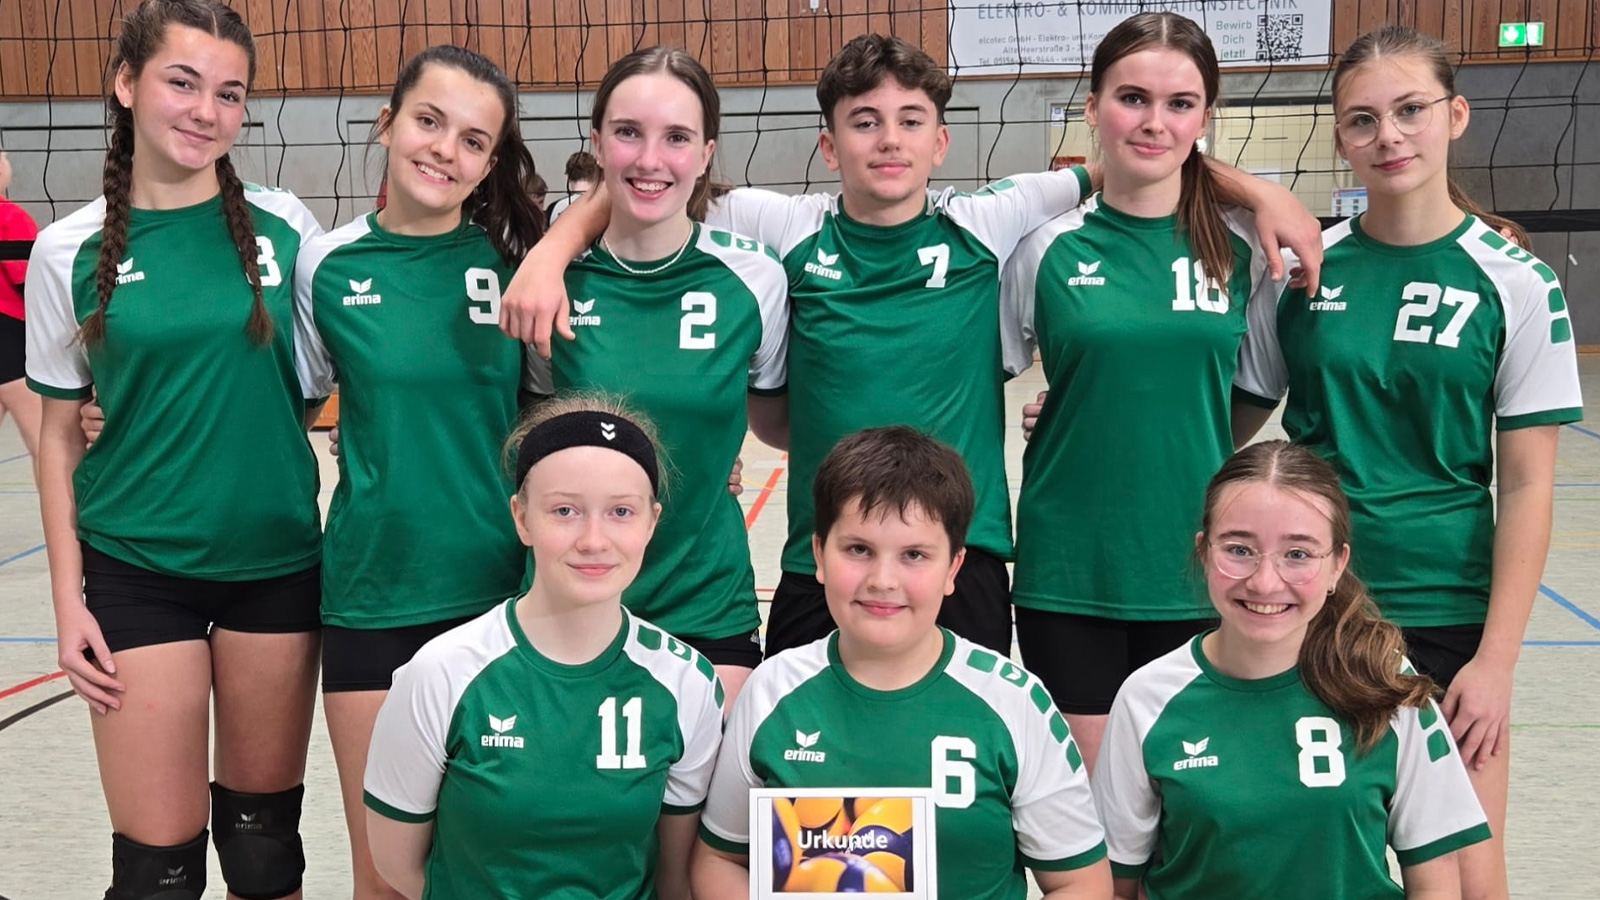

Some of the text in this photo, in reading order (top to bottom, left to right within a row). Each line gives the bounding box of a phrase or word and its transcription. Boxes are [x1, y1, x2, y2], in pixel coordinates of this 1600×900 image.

[978, 2, 1050, 20] ELEKTRO-
[1057, 1, 1068, 17] &
[1216, 20, 1252, 31] Bewirb
[1222, 35, 1245, 45] Dich
[1220, 49, 1246, 61] jetzt!
[804, 260, 842, 280] erima
[916, 243, 949, 288] 7
[115, 271, 145, 285] rima
[1068, 273, 1105, 286] erima
[1171, 256, 1230, 315] 18
[343, 293, 382, 306] erima
[464, 267, 501, 325] 9
[1309, 298, 1347, 311] erima
[679, 291, 717, 350] 2
[1394, 281, 1480, 349] 27
[481, 733, 525, 749] erima
[596, 696, 647, 770] 11
[784, 748, 826, 764] erima
[1295, 716, 1346, 788] 8
[931, 735, 977, 809] 6
[1173, 755, 1219, 771] erima
[797, 829, 889, 849] Urkunde
